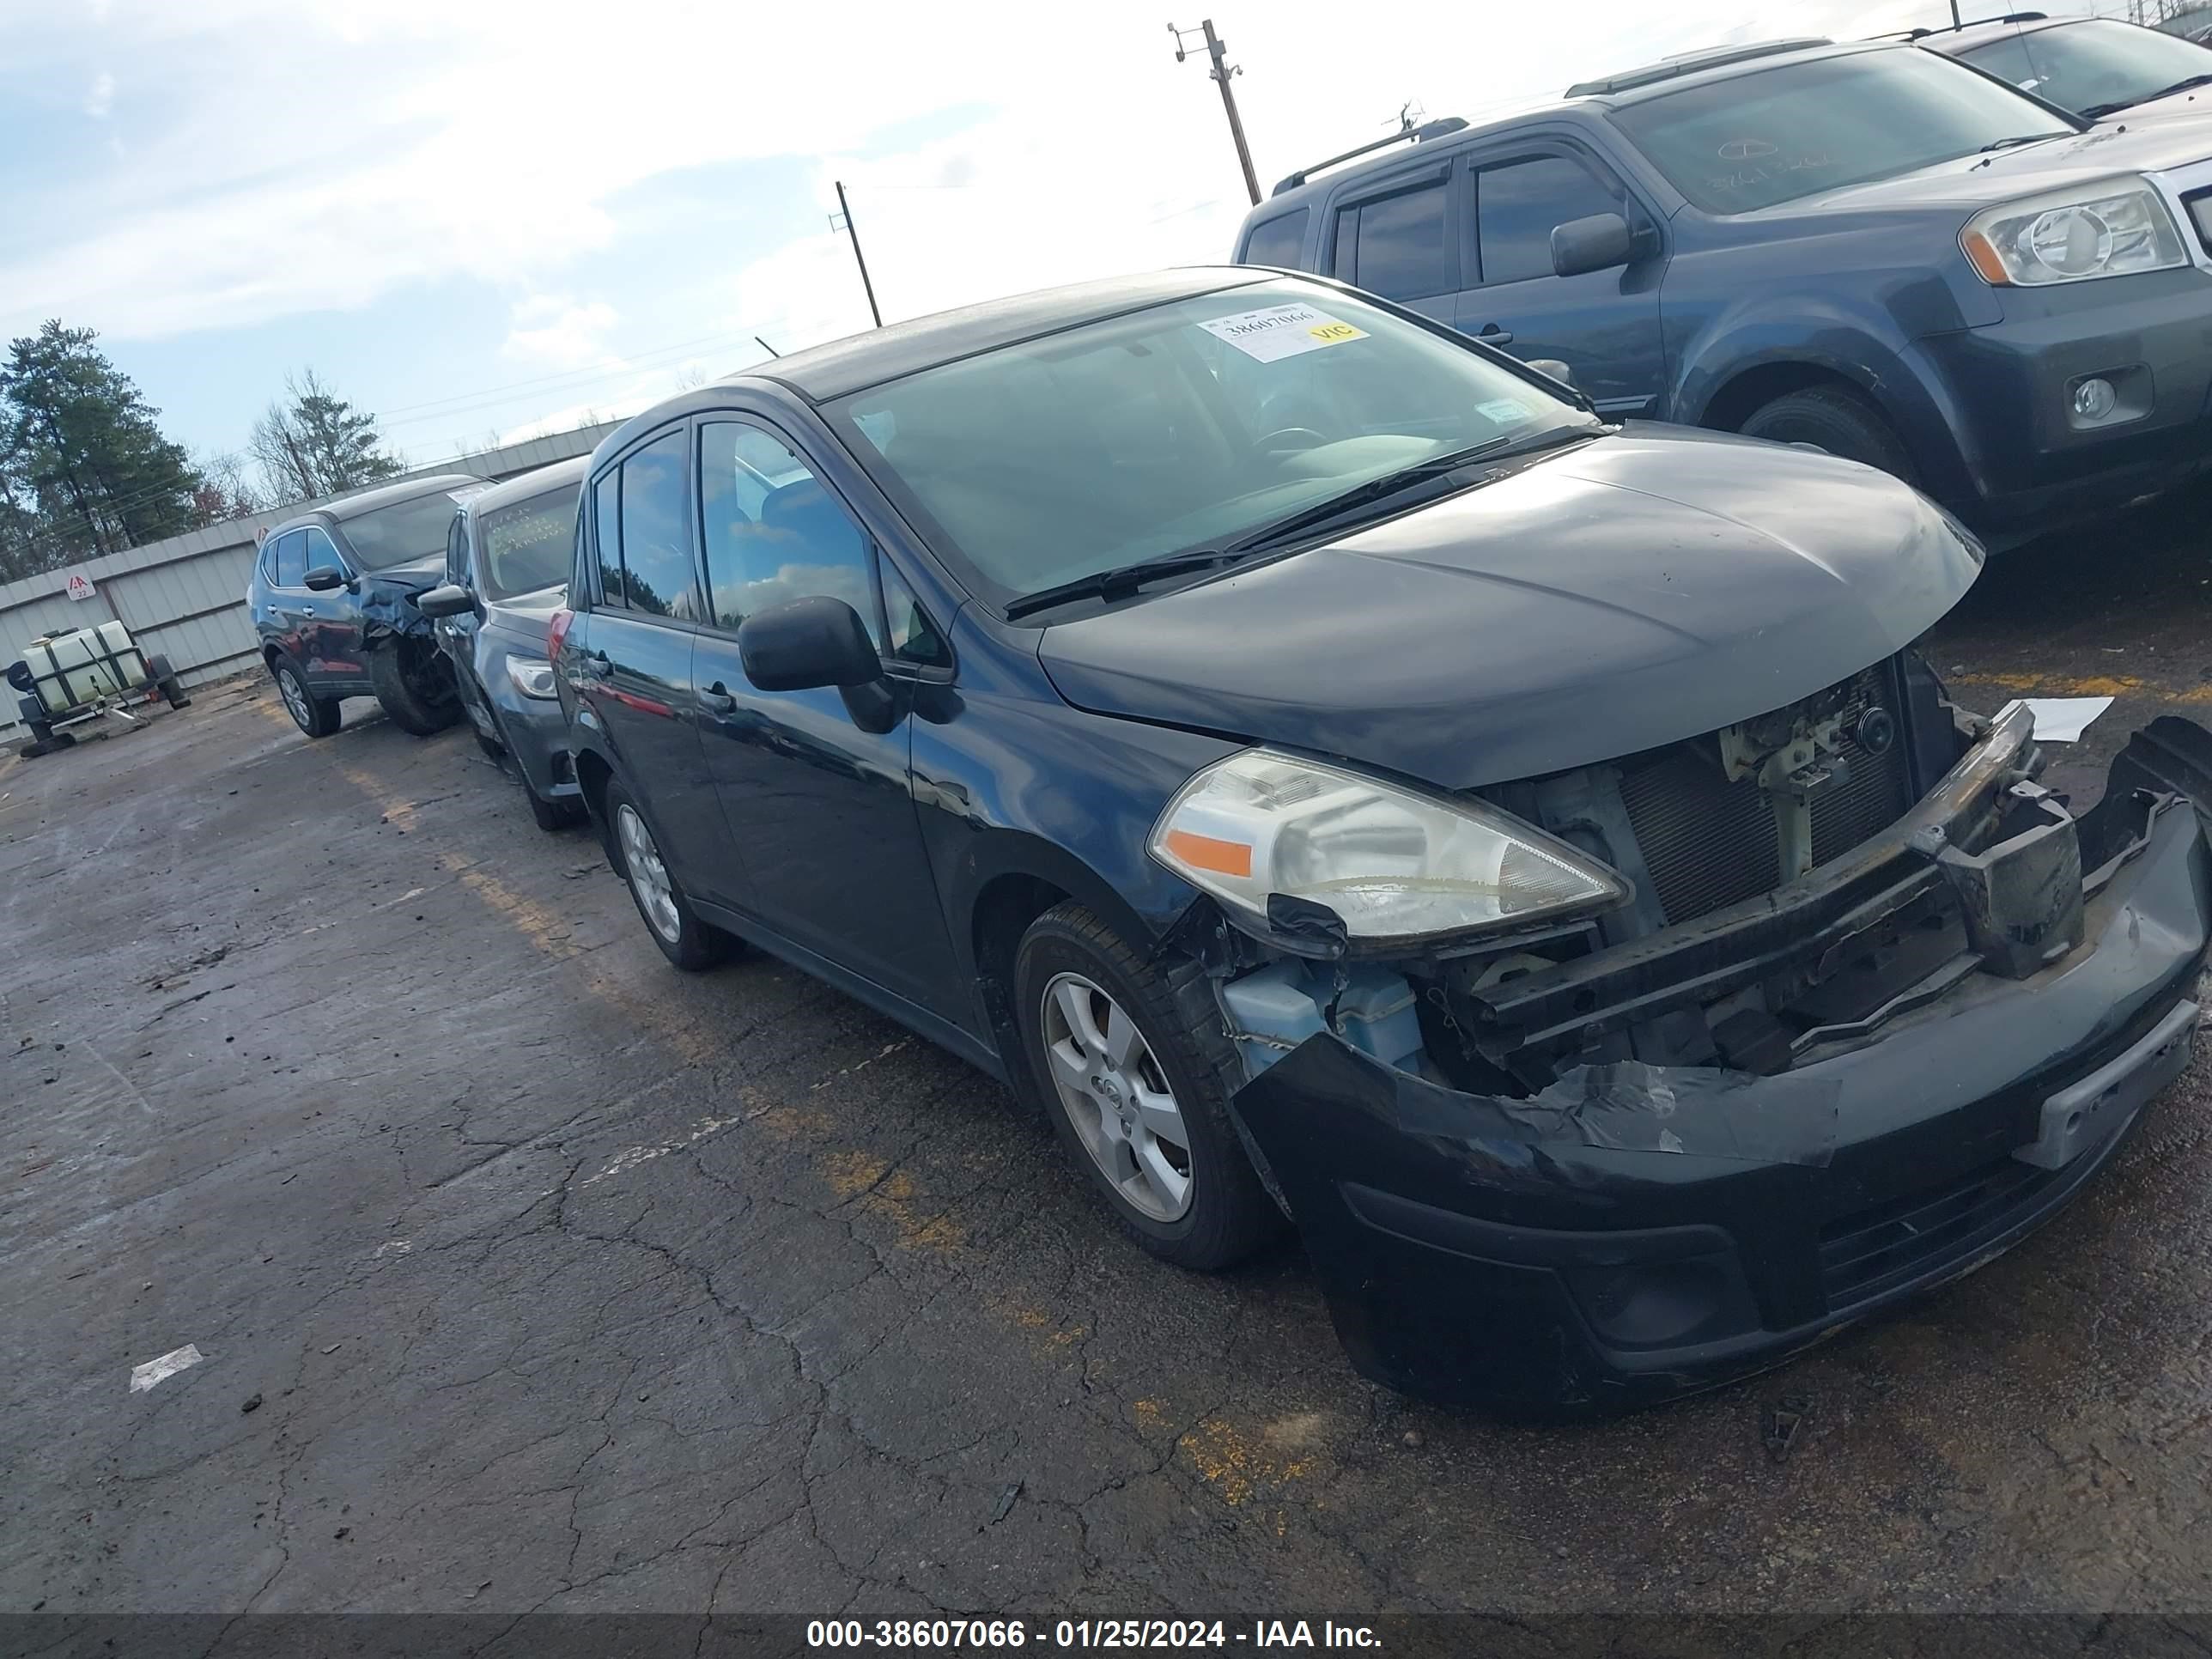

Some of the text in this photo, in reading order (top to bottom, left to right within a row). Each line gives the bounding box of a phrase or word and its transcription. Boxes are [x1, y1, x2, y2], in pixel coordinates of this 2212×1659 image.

[1225, 312, 1314, 337] 38607066
[1311, 325, 1353, 339] VIC
[76, 590, 88, 599] 22
